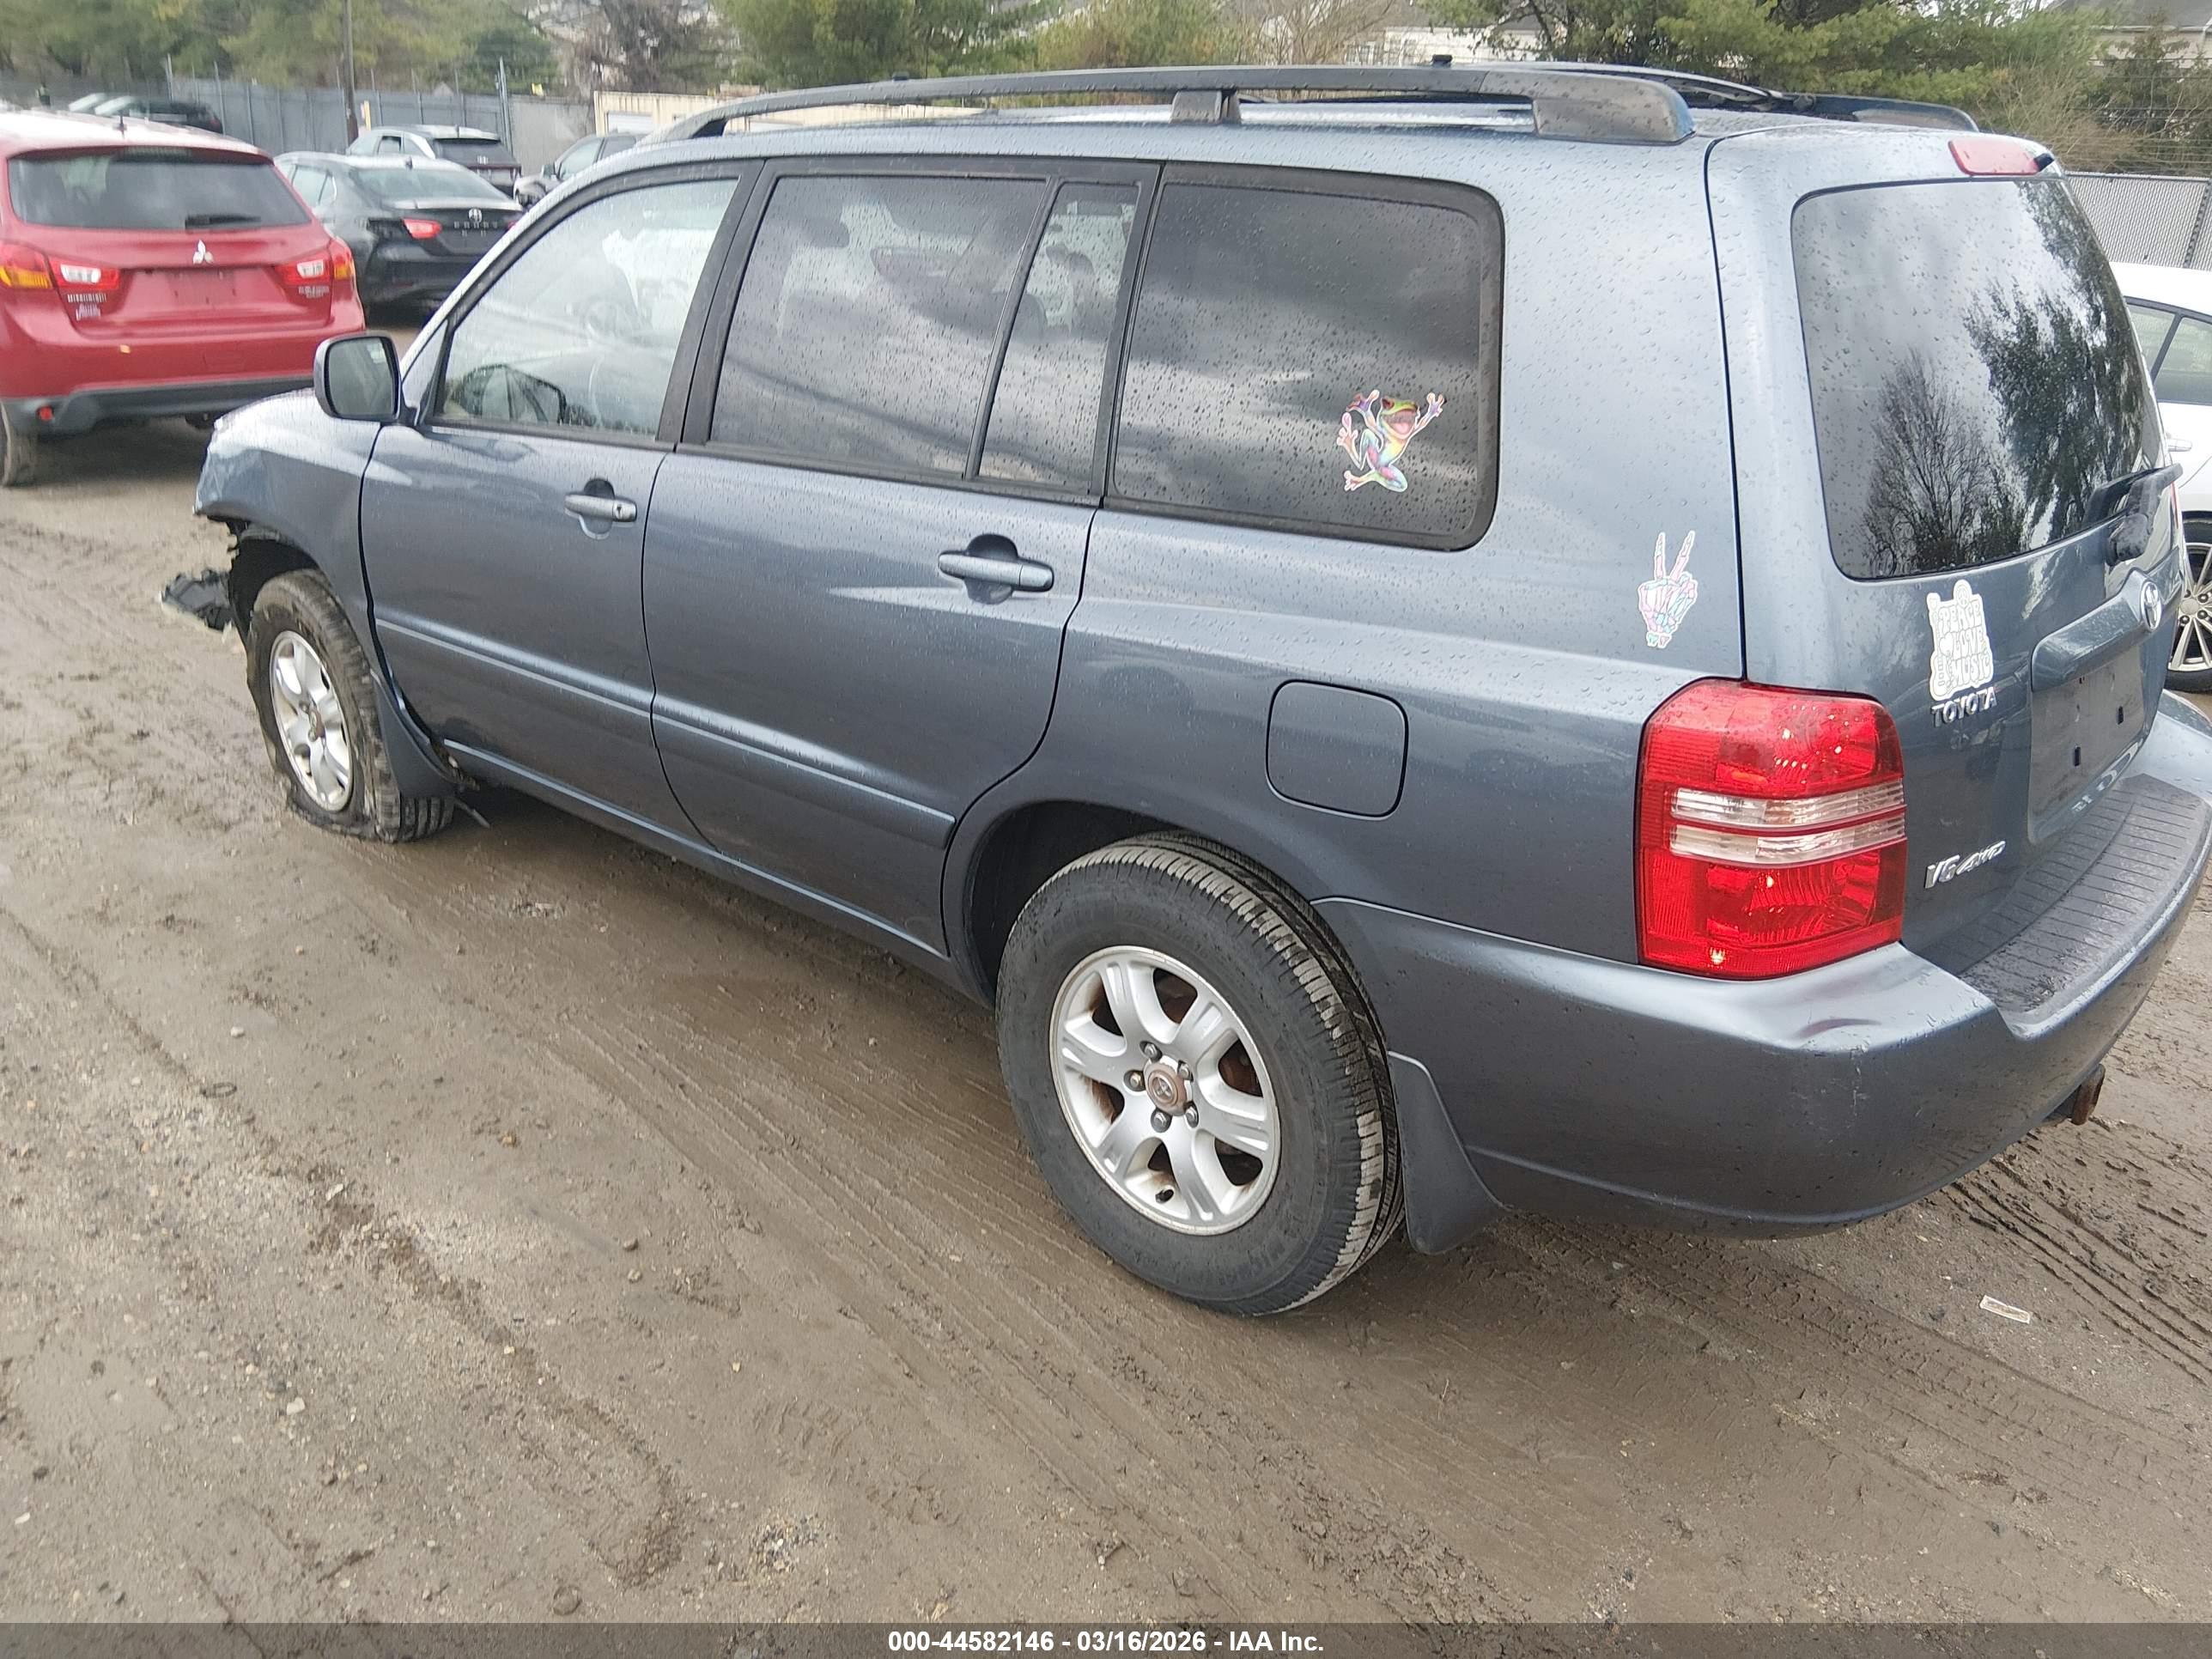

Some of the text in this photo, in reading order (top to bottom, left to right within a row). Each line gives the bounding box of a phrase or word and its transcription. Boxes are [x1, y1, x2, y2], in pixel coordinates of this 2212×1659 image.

[1938, 599, 1983, 637] PEACE
[1952, 627, 1986, 660] LOVE
[1948, 653, 1991, 687] MUSIC
[1931, 686, 1997, 728] TOYOTA
